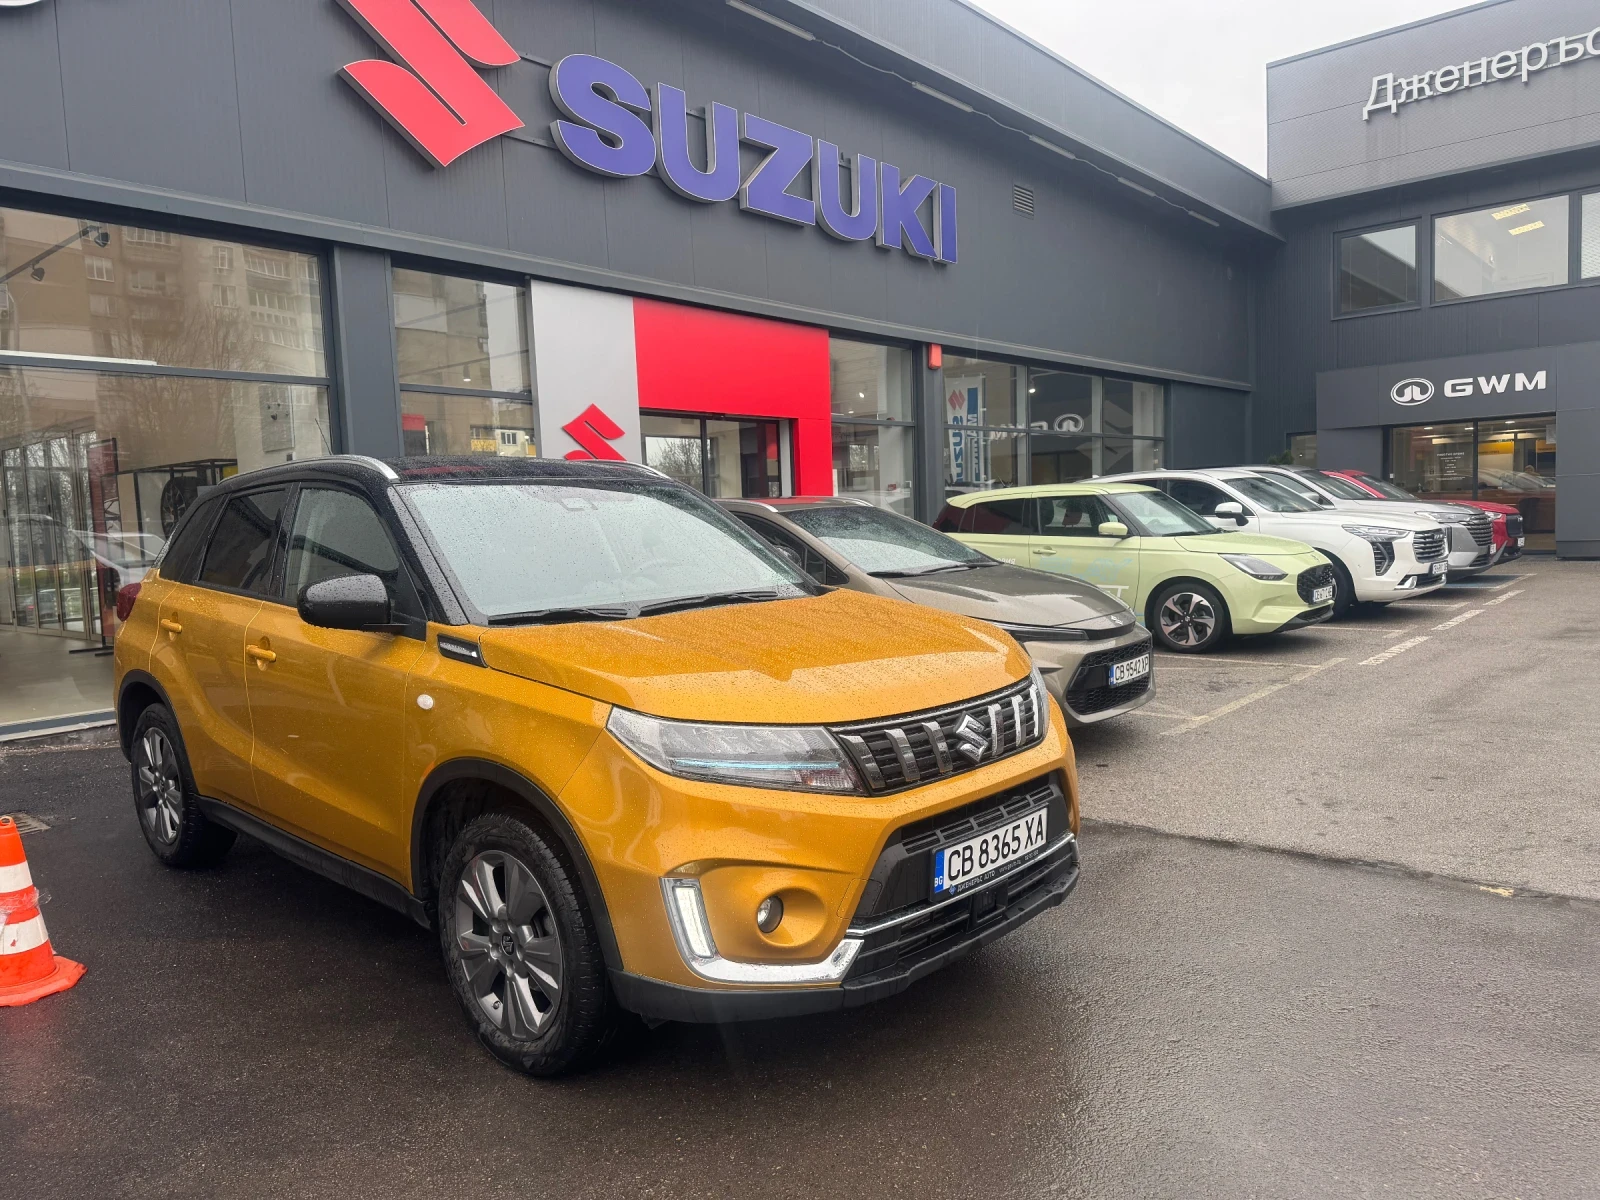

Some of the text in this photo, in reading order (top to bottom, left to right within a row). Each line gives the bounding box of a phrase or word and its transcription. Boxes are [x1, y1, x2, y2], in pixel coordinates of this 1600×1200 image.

[549, 54, 957, 264] SUZUKI
[1443, 370, 1547, 398] GWM
[948, 813, 1044, 882] CB 8365 XA
[934, 875, 944, 887] BG
